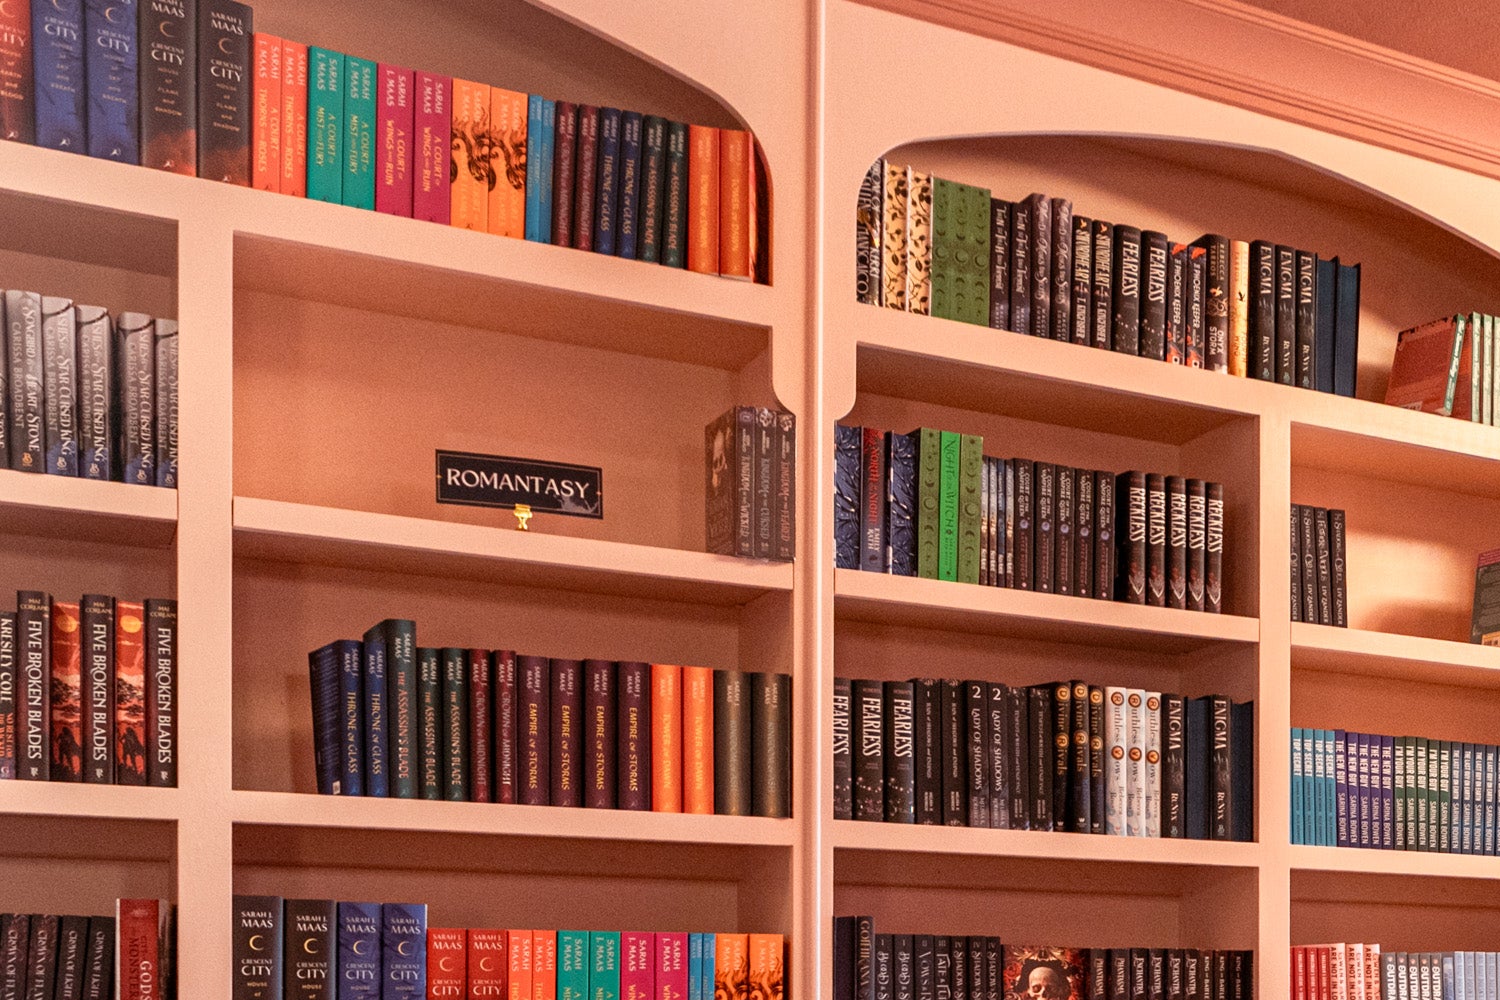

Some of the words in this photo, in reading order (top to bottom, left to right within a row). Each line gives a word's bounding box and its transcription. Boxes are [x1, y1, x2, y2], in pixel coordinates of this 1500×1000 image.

[152, 2, 185, 18] MAAS
[211, 18, 244, 36] MAAS
[44, 24, 79, 41] CITY
[97, 35, 131, 53] CITY
[151, 49, 184, 66] CITY
[210, 65, 243, 83] CITY
[328, 58, 337, 92] SARAH
[1122, 241, 1139, 298] FEARLESS
[1148, 246, 1166, 303] FEARLESS
[1260, 246, 1272, 294] ENIGMA
[1280, 251, 1292, 299] ENIGMA
[1300, 255, 1312, 304] ENIGMA
[446, 468, 590, 499] ROMANTASY
[1130, 487, 1145, 542] RECKLESS
[1150, 491, 1165, 545] RECKLESS
[1171, 493, 1186, 548] RECKLESS
[1189, 496, 1204, 550] RECKLESS
[1208, 499, 1223, 553] RECKLESS
[28, 620, 42, 649] FIVE
[93, 624, 106, 651] FIVE
[158, 628, 171, 656] FIVE
[25, 652, 42, 710] BROKEN
[91, 655, 107, 708] BROKEN
[156, 659, 171, 711] BROKEN
[347, 692, 356, 731] THRONE
[529, 703, 538, 737] EMPIRE
[562, 705, 571, 738] EMPIRE
[833, 695, 849, 754] FEARLESS
[862, 697, 881, 756] FEARLESS
[894, 699, 912, 757] FEARLESS
[1169, 700, 1181, 750] ENIGMA
[1214, 700, 1227, 749] ENIGMA
[28, 711, 42, 759] BLADES
[93, 712, 107, 761] BLADES
[158, 715, 172, 763] BLADES
[529, 751, 538, 790] STORMS
[561, 752, 571, 791] STORMS
[1293, 752, 1302, 777] SECRET
[1336, 771, 1346, 784] GUY
[1395, 758, 1404, 774] YOUR
[1395, 776, 1404, 788] GUY
[241, 918, 274, 929] MAAS
[296, 922, 328, 932] MAAS
[391, 924, 421, 935] MAAS
[432, 940, 463, 951] MAAS
[241, 965, 274, 977] CITY
[296, 968, 329, 980] CITY
[345, 969, 376, 981] CITY
[473, 984, 502, 996] CITY
